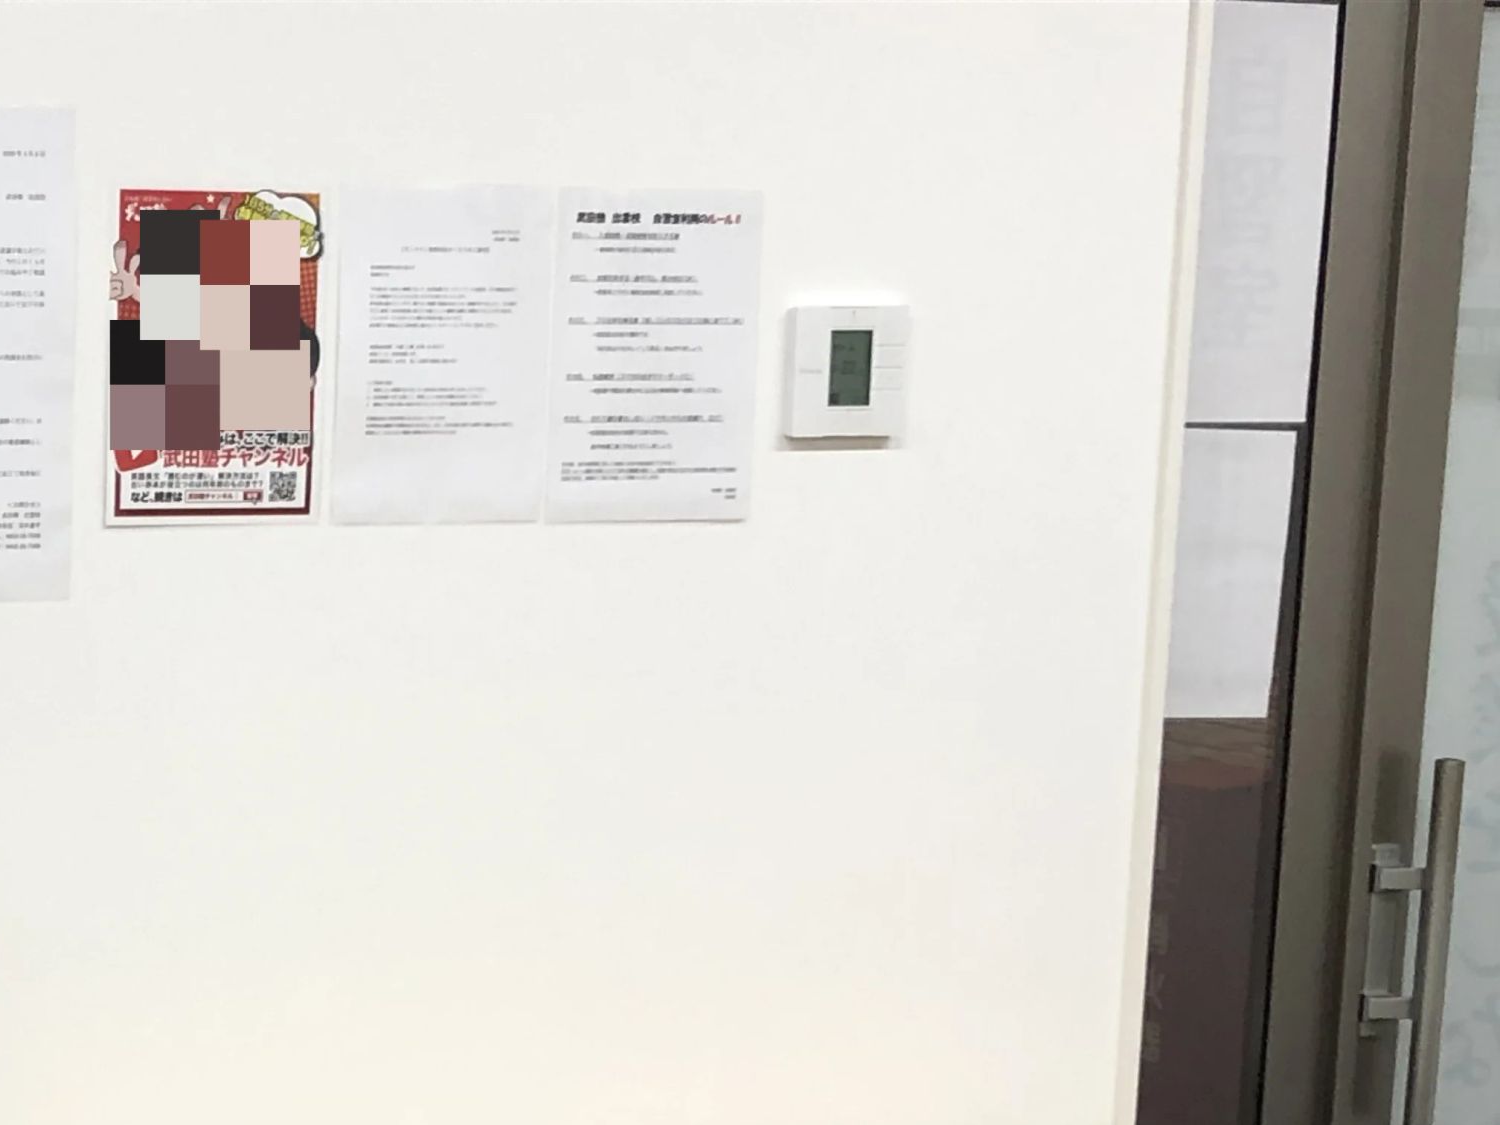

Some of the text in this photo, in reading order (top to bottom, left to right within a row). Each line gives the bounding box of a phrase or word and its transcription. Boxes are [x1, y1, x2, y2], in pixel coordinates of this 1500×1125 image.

[162, 448, 309, 469] 武田塾チャンネル
